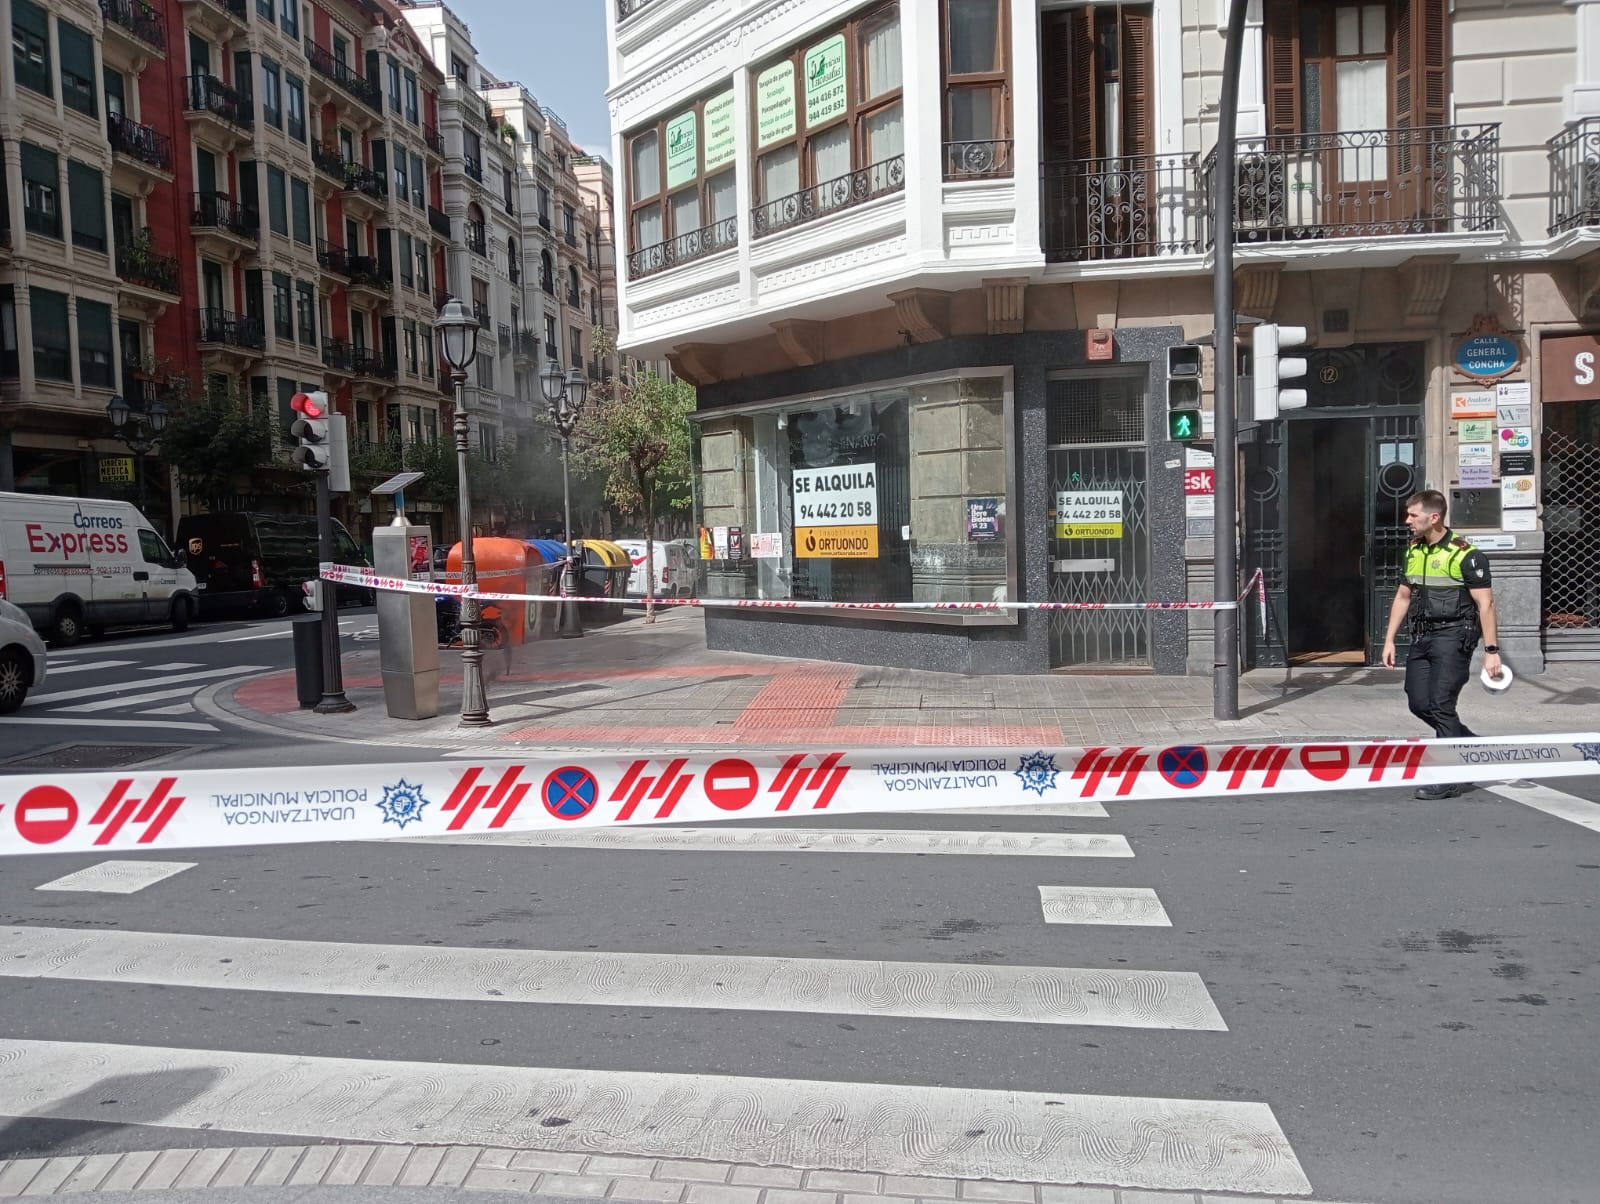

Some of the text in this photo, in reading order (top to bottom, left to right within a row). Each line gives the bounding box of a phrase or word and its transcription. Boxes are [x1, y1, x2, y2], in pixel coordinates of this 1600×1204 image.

[808, 96, 819, 108] 944
[808, 110, 820, 122] 944
[820, 104, 832, 116] 419
[1467, 347, 1508, 357] GENERAL
[1468, 360, 1505, 368] CONCHA
[1574, 352, 1594, 385] S
[1323, 368, 1335, 381] 12
[795, 472, 876, 493] SE ALQUILA
[1058, 496, 1120, 506] SE ALQUILA
[800, 501, 872, 520] 94 442 20 58
[1058, 510, 1121, 519] 94 442 20 58
[74, 513, 122, 529] Correos
[25, 524, 128, 560] Express
[818, 538, 869, 550] ORTUONDO
[1460, 747, 1561, 764] UDALTZAINGOA
[872, 758, 1006, 776] POLICIA MUNICIPAL
[884, 775, 998, 792] UDALTZAINGOA
[211, 788, 368, 808] POLICIA MUNICIPAL
[224, 806, 356, 825] UDALTZAINGOA
